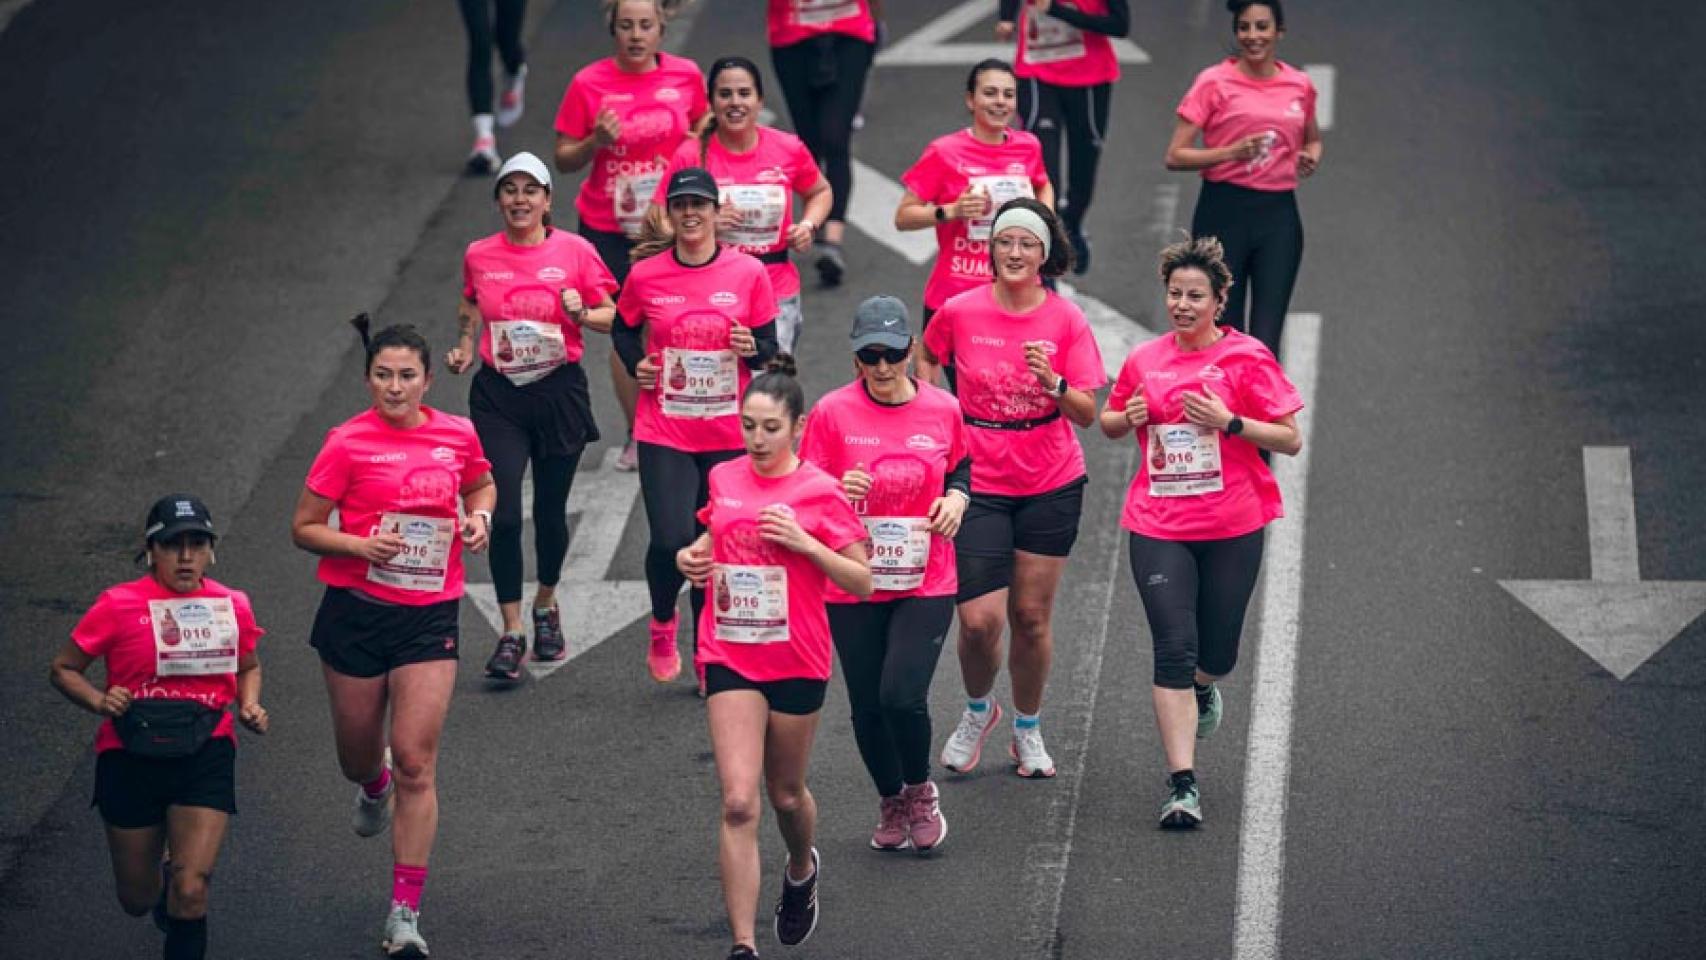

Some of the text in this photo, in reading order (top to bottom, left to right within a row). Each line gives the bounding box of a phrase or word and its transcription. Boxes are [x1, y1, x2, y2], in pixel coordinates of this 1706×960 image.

[516, 345, 541, 357] 016
[689, 376, 715, 388] 016
[1167, 451, 1193, 464] 016
[402, 544, 427, 558] 016
[877, 545, 904, 557] 016
[733, 595, 759, 608] 016
[183, 627, 211, 639] 016
